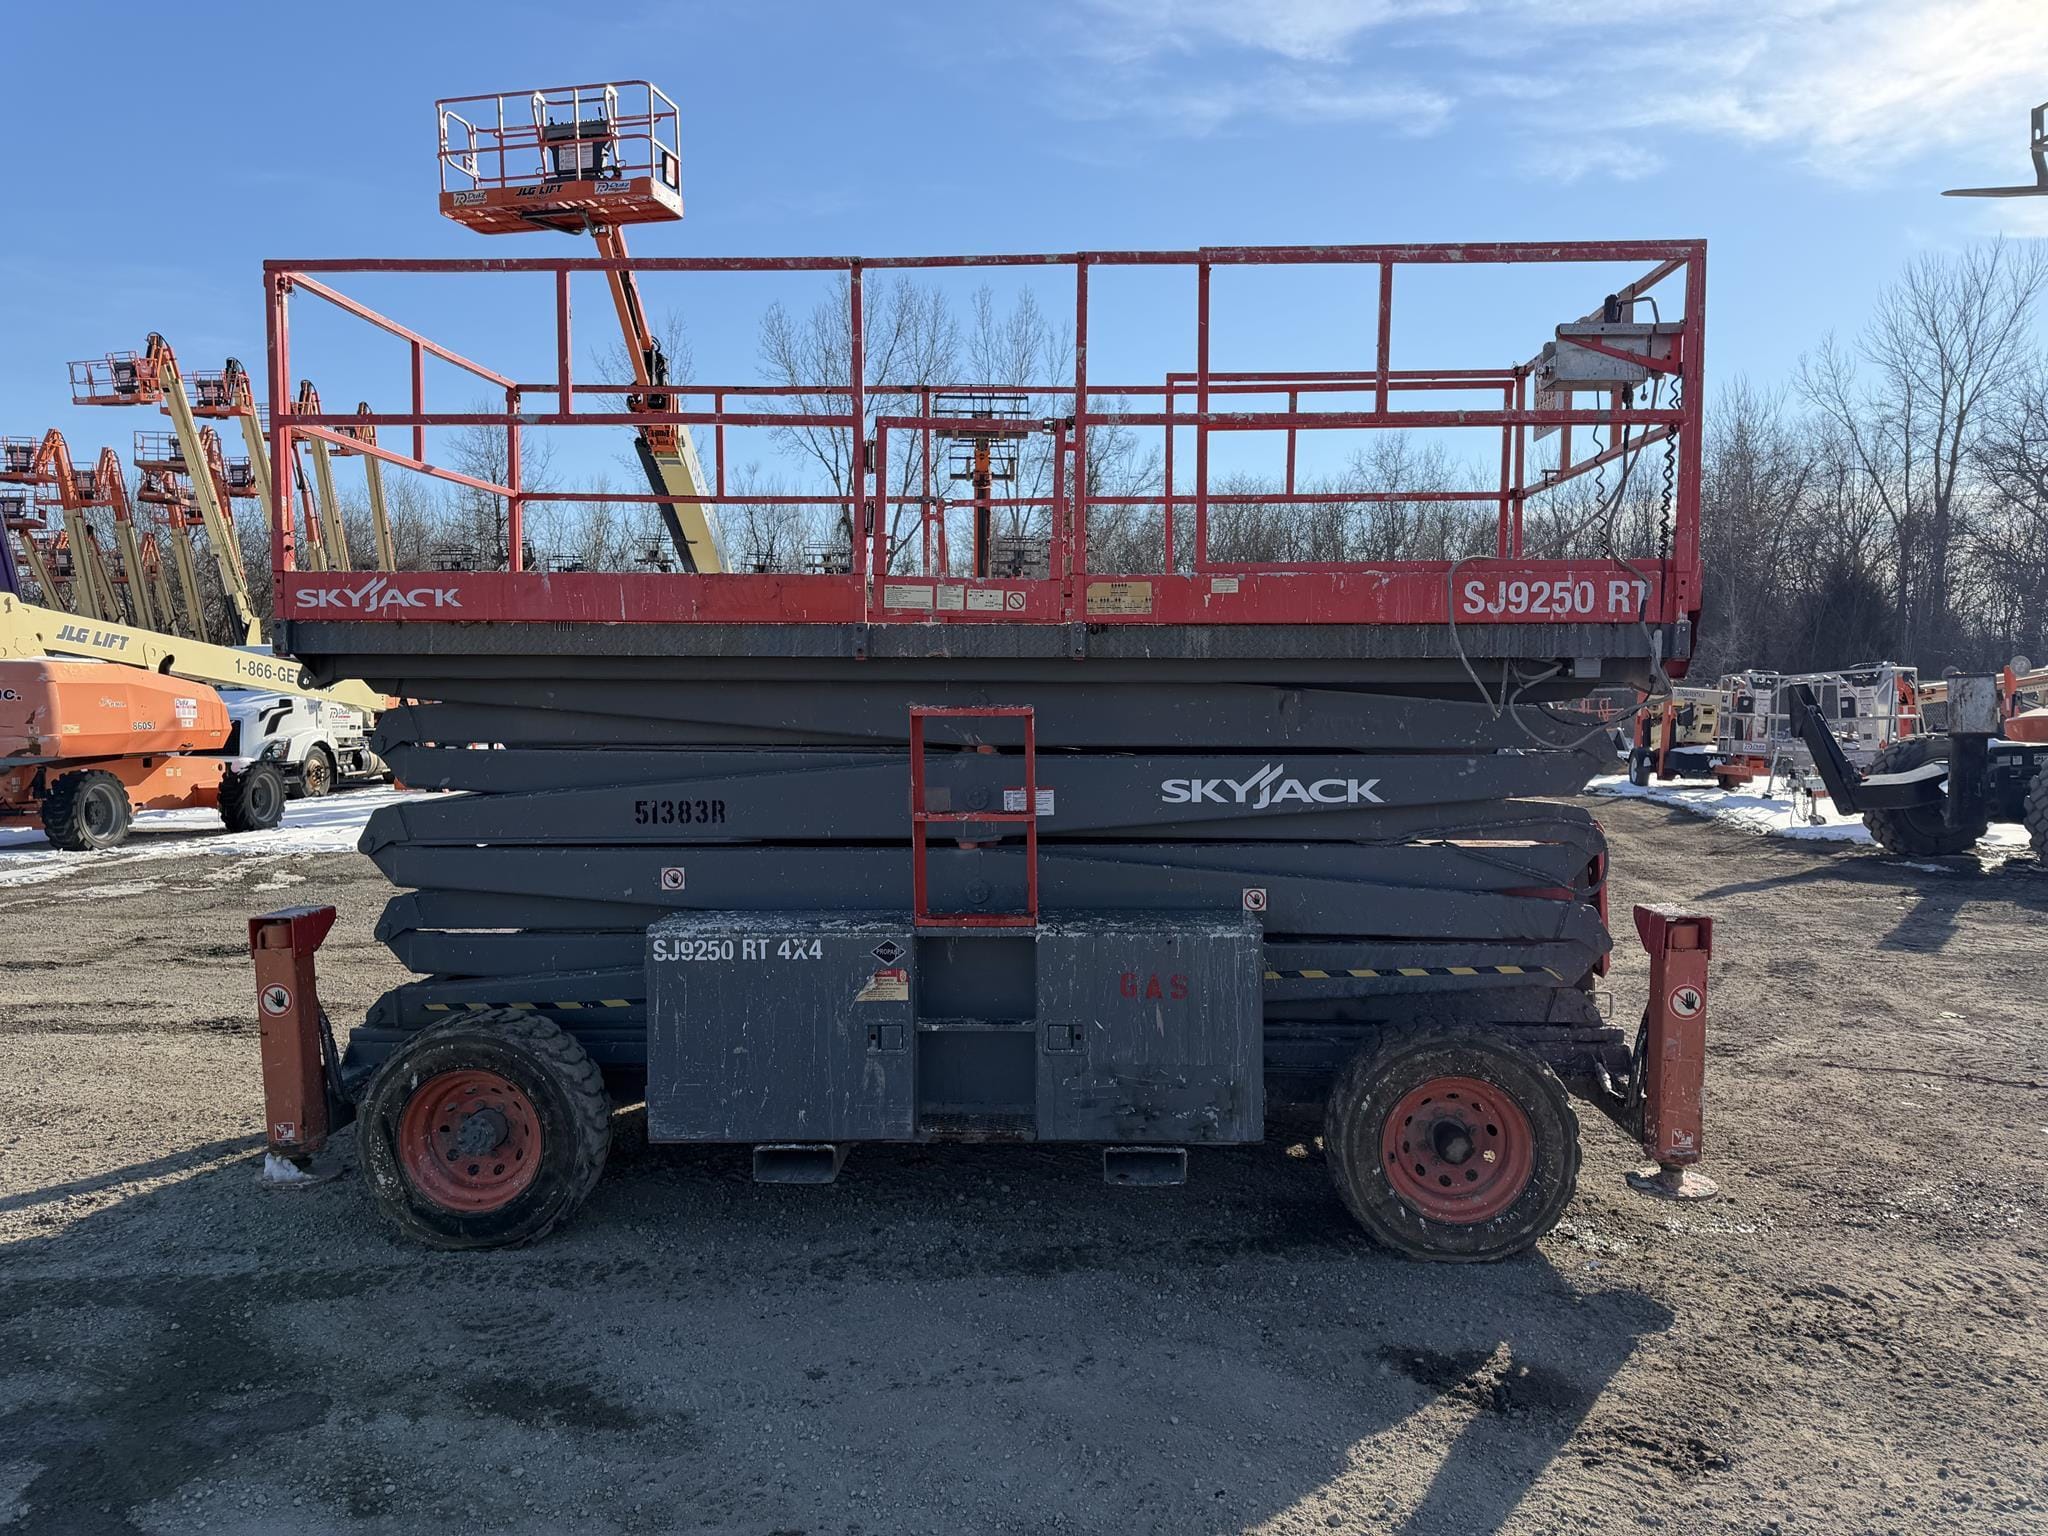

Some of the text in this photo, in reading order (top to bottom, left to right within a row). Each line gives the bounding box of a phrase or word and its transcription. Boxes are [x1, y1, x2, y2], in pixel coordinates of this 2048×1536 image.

[516, 184, 563, 196] JLG LIFT
[296, 577, 463, 613] SKYJACK
[1463, 580, 1649, 614] SJ9250 RT
[56, 624, 130, 650] JLG LIFT
[0, 689, 22, 700] c.
[1161, 763, 1386, 810] SKYJACK
[635, 800, 725, 824] 51383R
[653, 939, 823, 961] SJ9250 RT 4X4
[1120, 973, 1189, 1000] GAS
